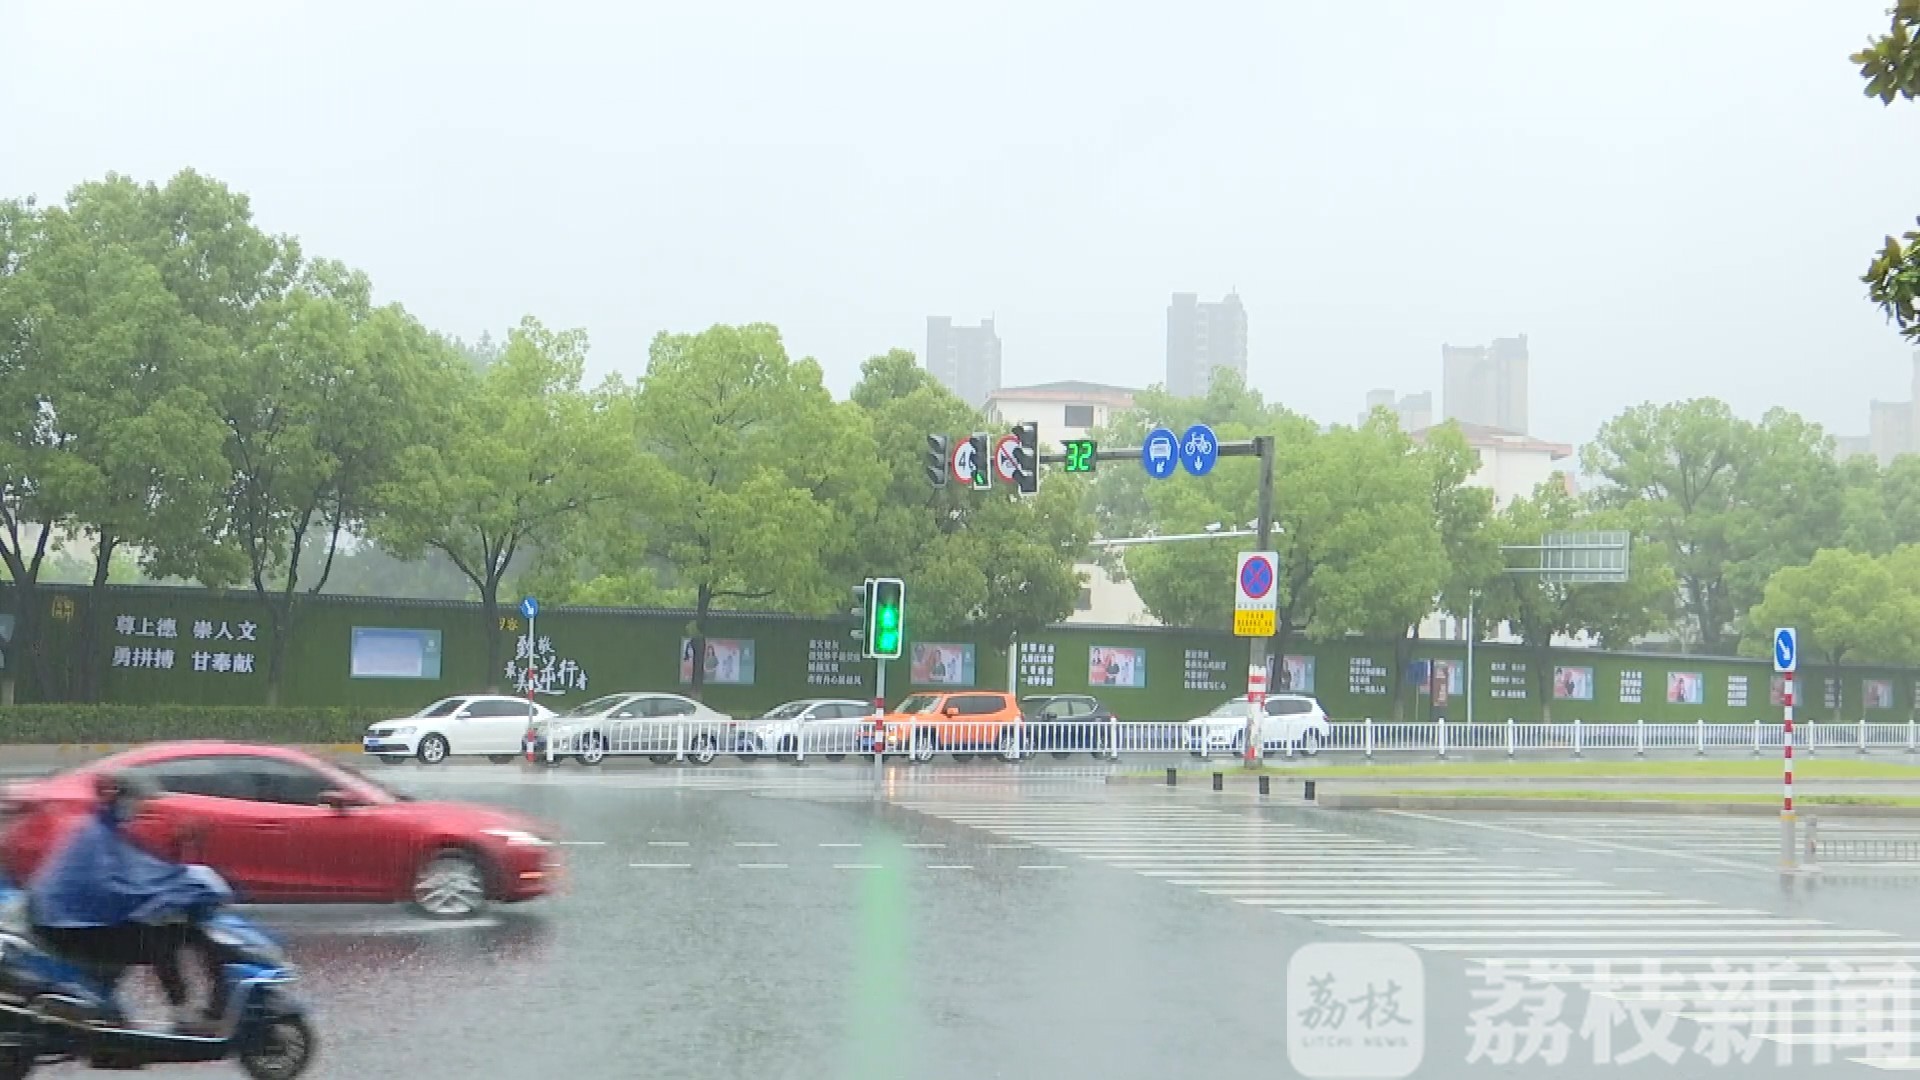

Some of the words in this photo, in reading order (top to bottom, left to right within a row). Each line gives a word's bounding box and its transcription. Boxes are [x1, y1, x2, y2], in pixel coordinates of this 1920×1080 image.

[1066, 443, 1092, 471] 32
[115, 614, 177, 638] 尊上德
[192, 619, 258, 641] 崇人文
[112, 646, 175, 669] 勇拼搏
[191, 651, 255, 673] 甘奉献
